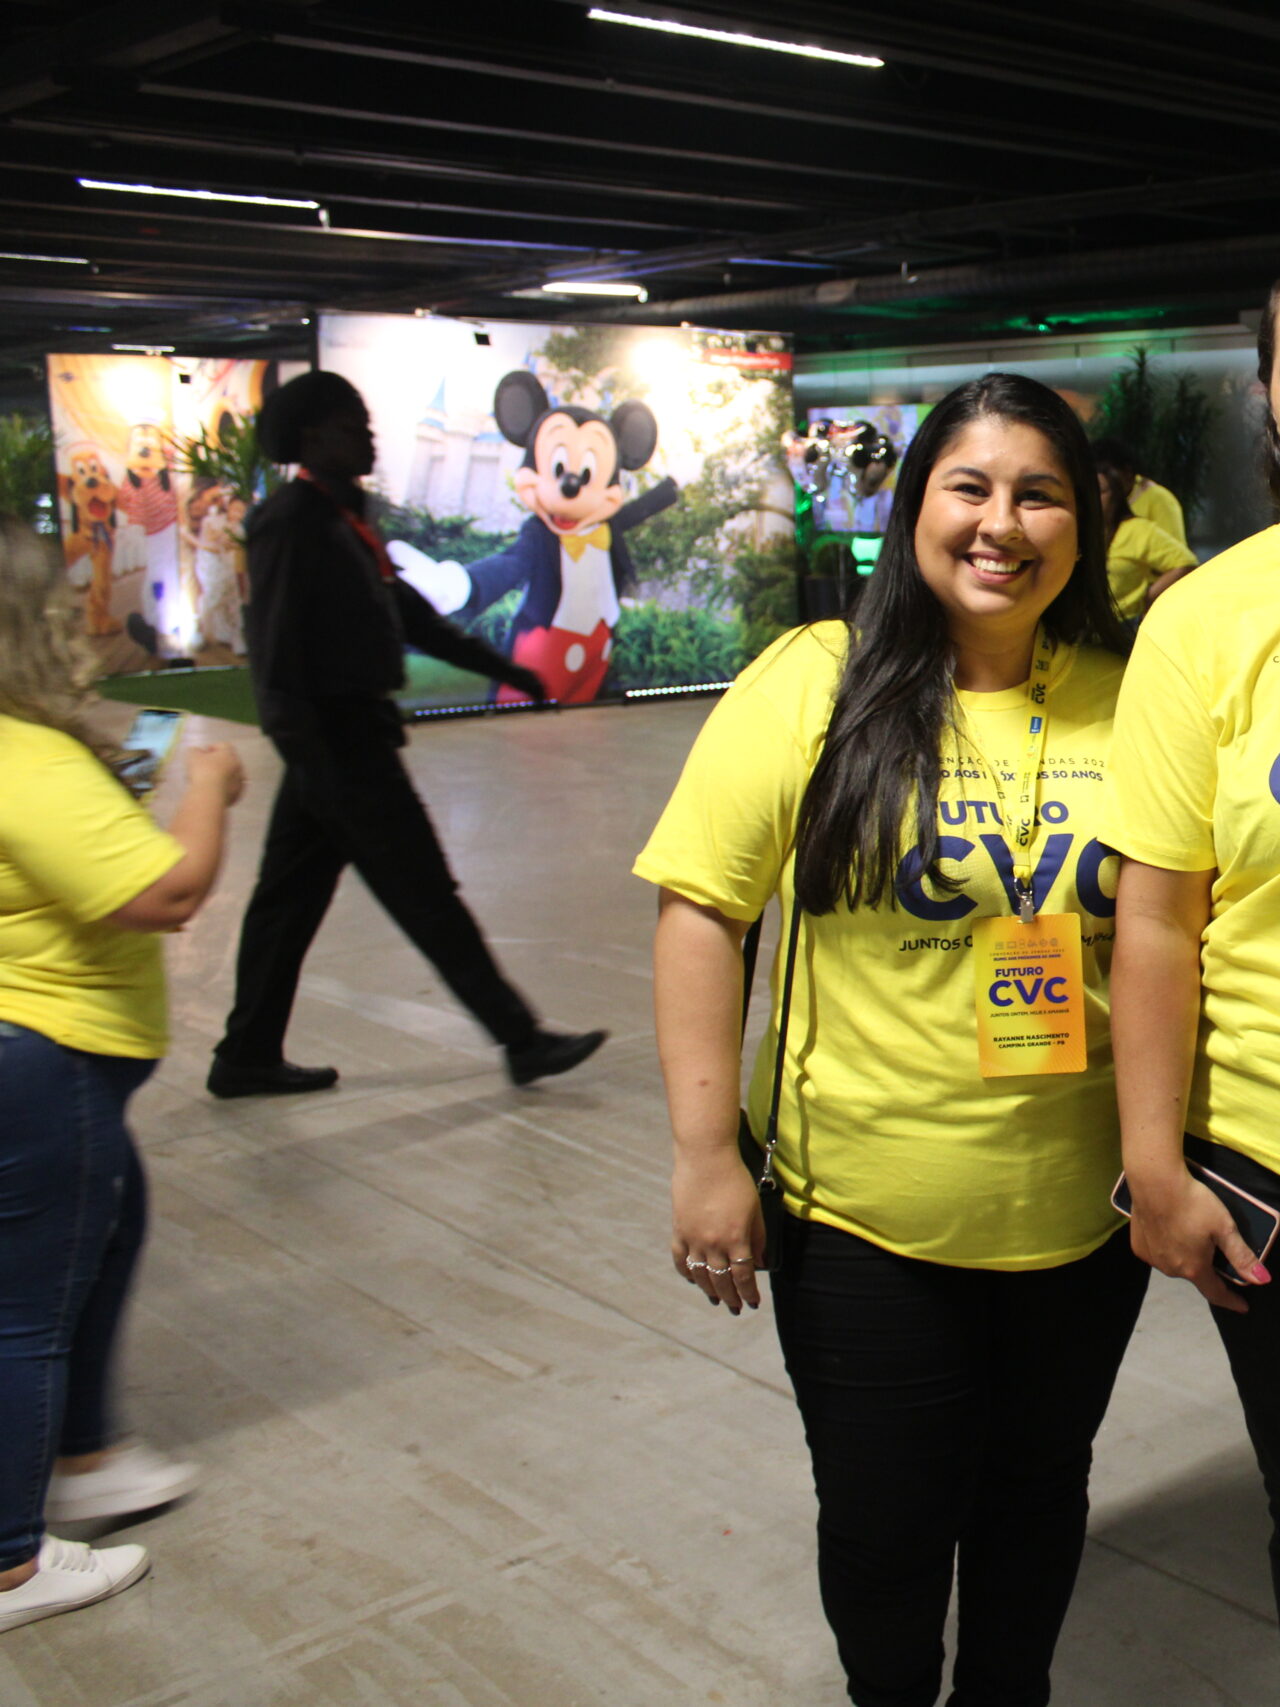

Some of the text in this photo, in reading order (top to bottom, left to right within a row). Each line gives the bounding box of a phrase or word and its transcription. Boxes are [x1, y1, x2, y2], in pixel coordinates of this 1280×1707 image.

[955, 769, 980, 778] AOS
[1052, 770, 1068, 778] 50
[1071, 770, 1103, 782] ANOS
[1020, 818, 1031, 847] CVC
[899, 936, 960, 951] JUNTOS
[995, 966, 1044, 978] FUTURO
[988, 976, 1069, 1007] CVC
[1026, 1032, 1070, 1041] NASCIMENTO
